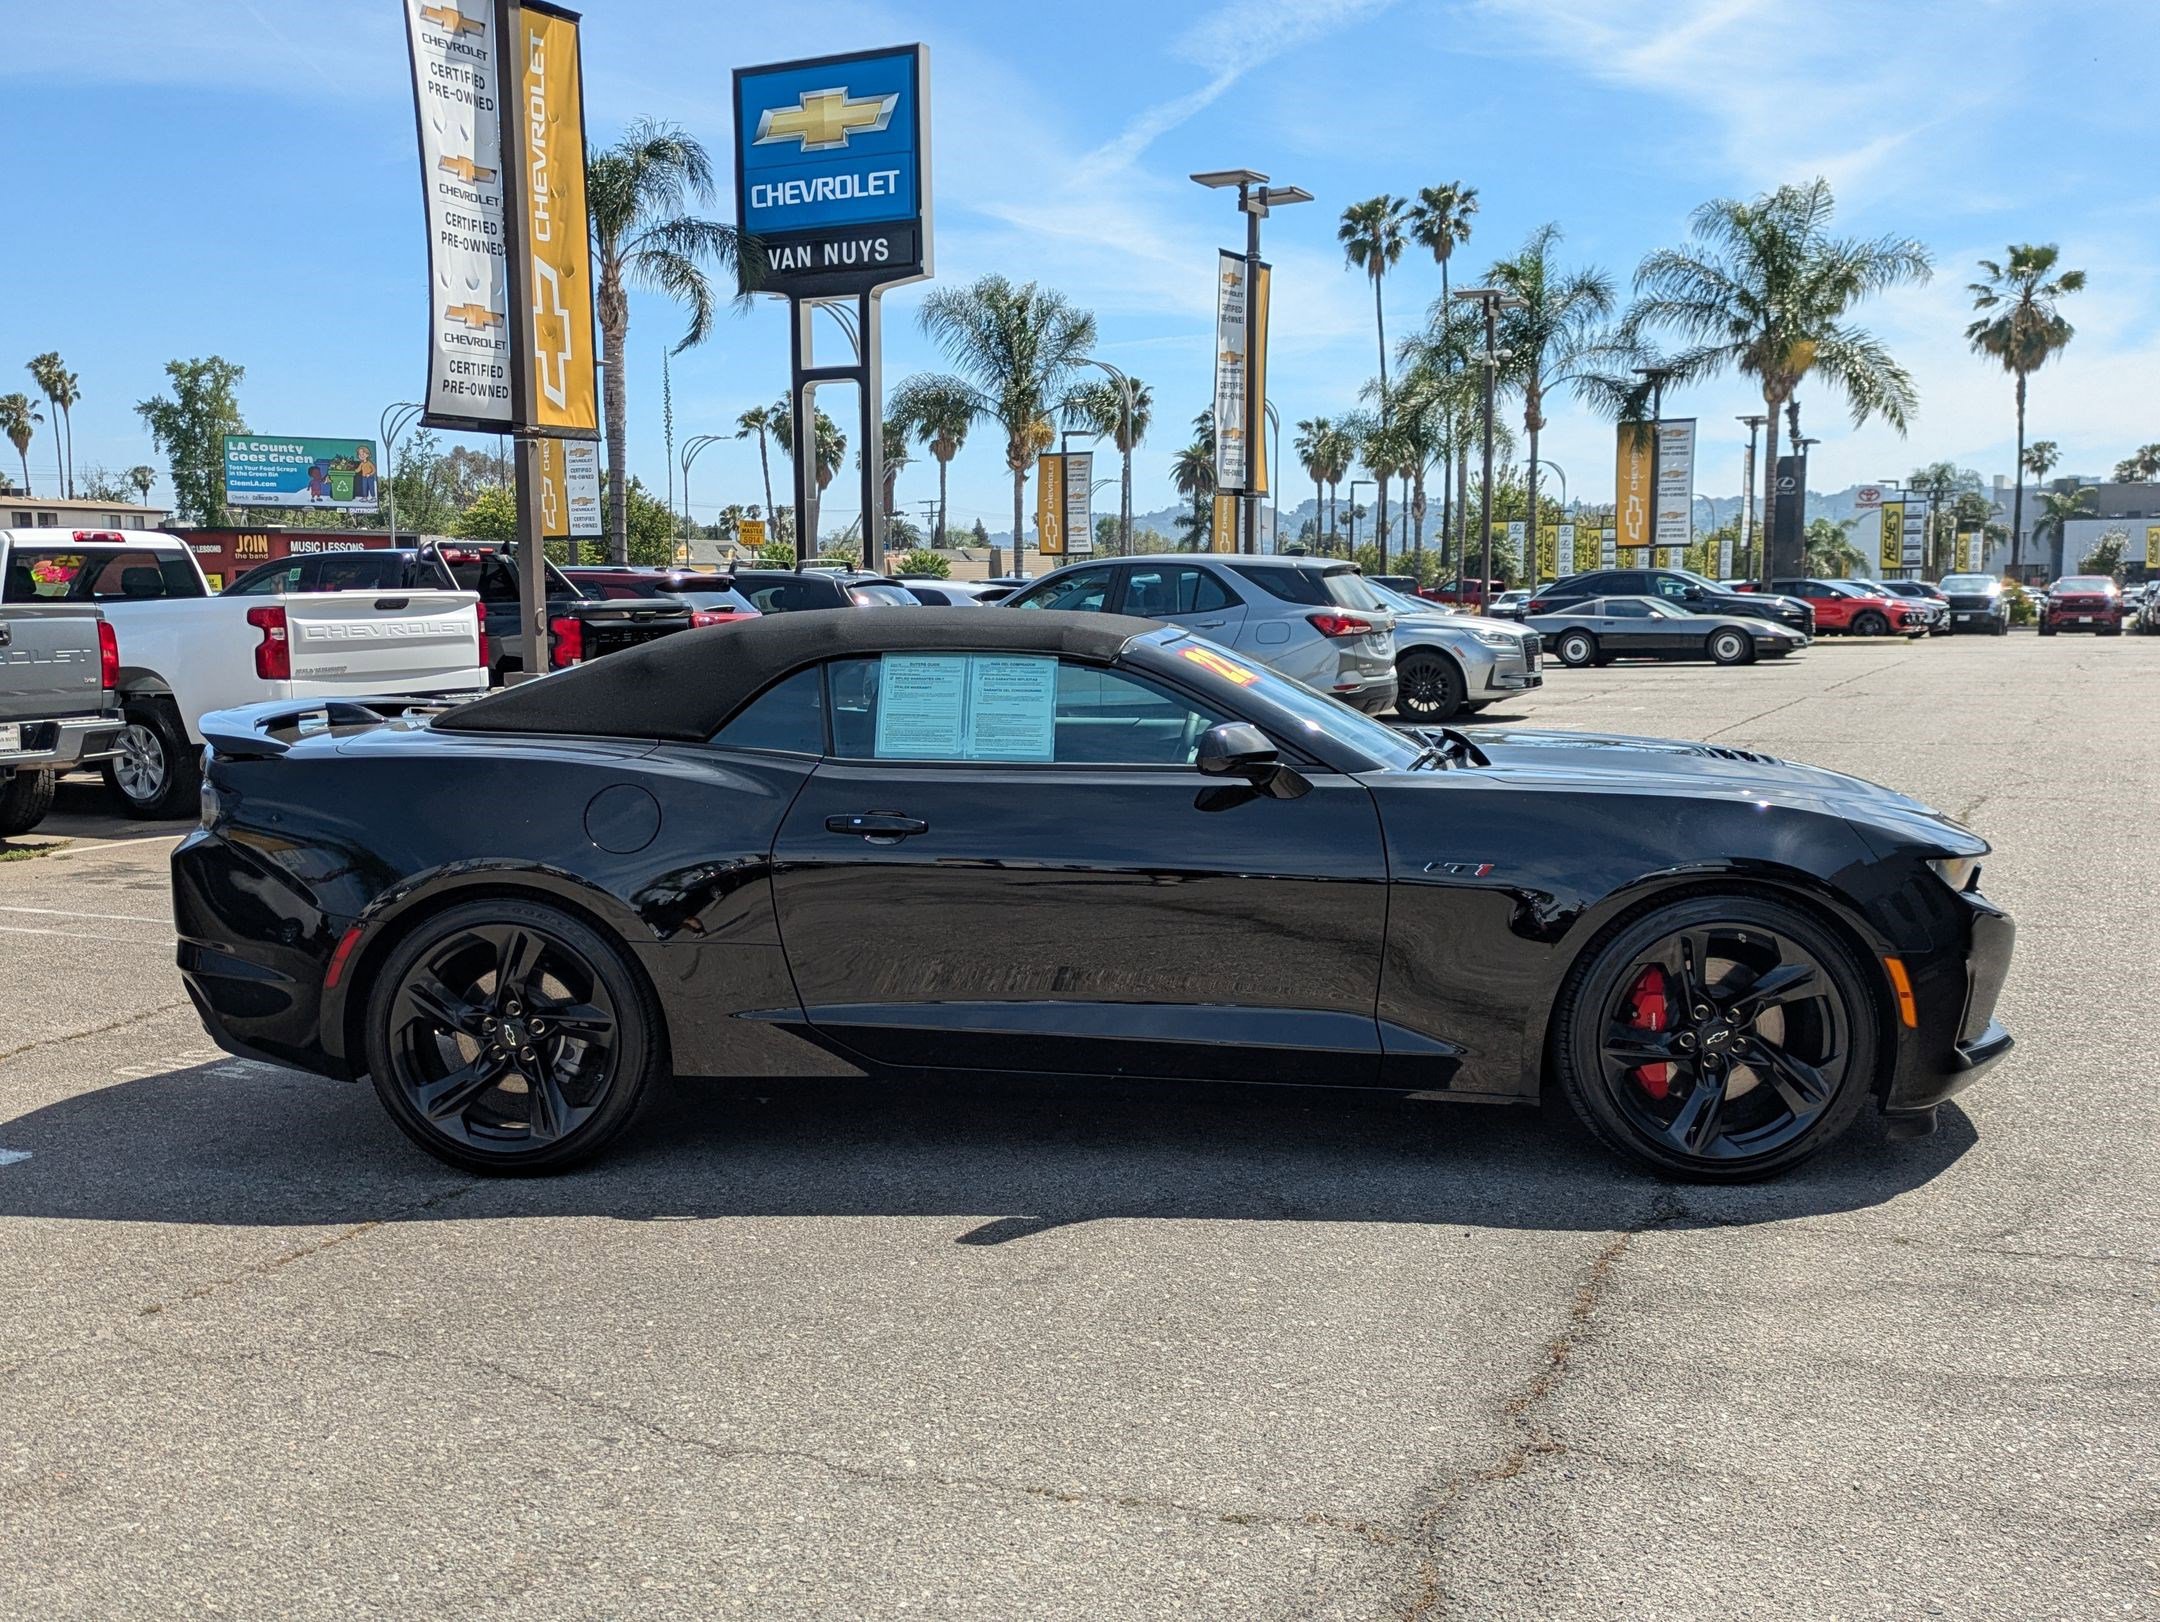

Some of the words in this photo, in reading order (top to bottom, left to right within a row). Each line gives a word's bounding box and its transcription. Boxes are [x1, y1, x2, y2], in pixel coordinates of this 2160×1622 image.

[422, 33, 489, 62] CHEVROLET
[430, 62, 486, 90] CERTIFIED
[428, 81, 494, 112] PRE-OWNED
[530, 28, 550, 242] CHEVROLET
[439, 183, 500, 208] CHEVROLET
[751, 169, 900, 209] CHEVROLET
[445, 212, 498, 236] CERTIFIED
[441, 231, 504, 257] PRE-OWNED
[768, 245, 811, 271] VAN
[824, 238, 889, 266] NUYS
[444, 332, 507, 351] CHEVROLET
[449, 360, 504, 379] CERTIFIED
[442, 379, 509, 399] PRE-OWNED
[229, 441, 248, 451] LA
[250, 442, 304, 455] County
[229, 451, 267, 463] Goes
[269, 453, 314, 464] Green
[230, 480, 277, 488] CleanLA.com
[235, 534, 268, 553] JOIN
[290, 541, 321, 552] MUSIC
[322, 542, 365, 552] LESSONS
[1883, 509, 1900, 563] KEYES
[196, 545, 222, 553] LESSONS
[1544, 530, 1556, 574] KEYES
[305, 622, 469, 640] CHEVROLET
